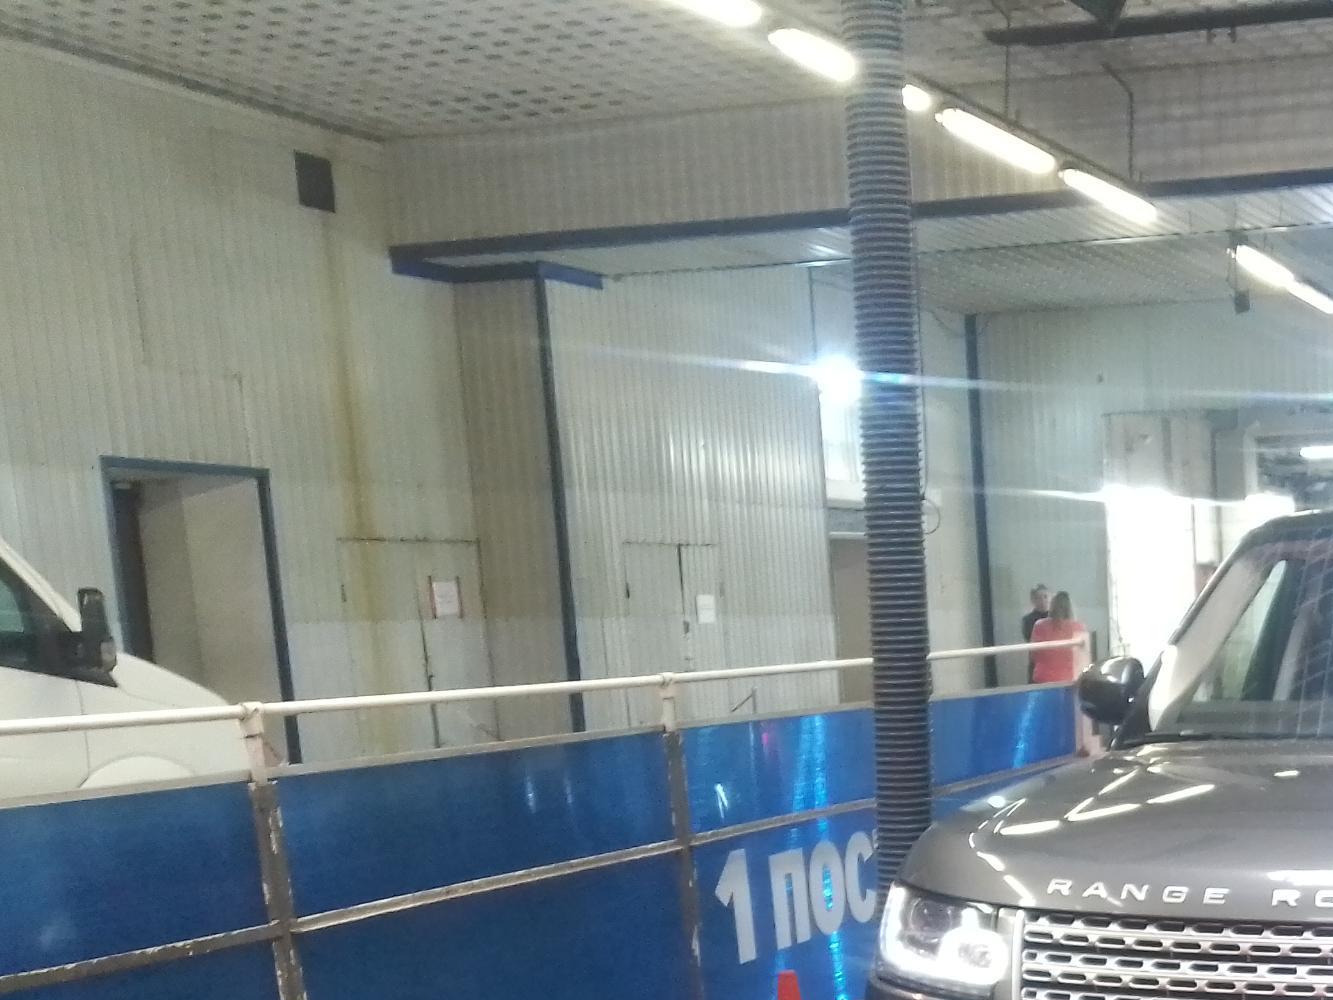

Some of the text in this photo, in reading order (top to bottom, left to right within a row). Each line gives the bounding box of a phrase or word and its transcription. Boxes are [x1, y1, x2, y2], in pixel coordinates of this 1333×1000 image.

[715, 827, 880, 965] 1 ПОС
[1047, 877, 1231, 905] RANGE
